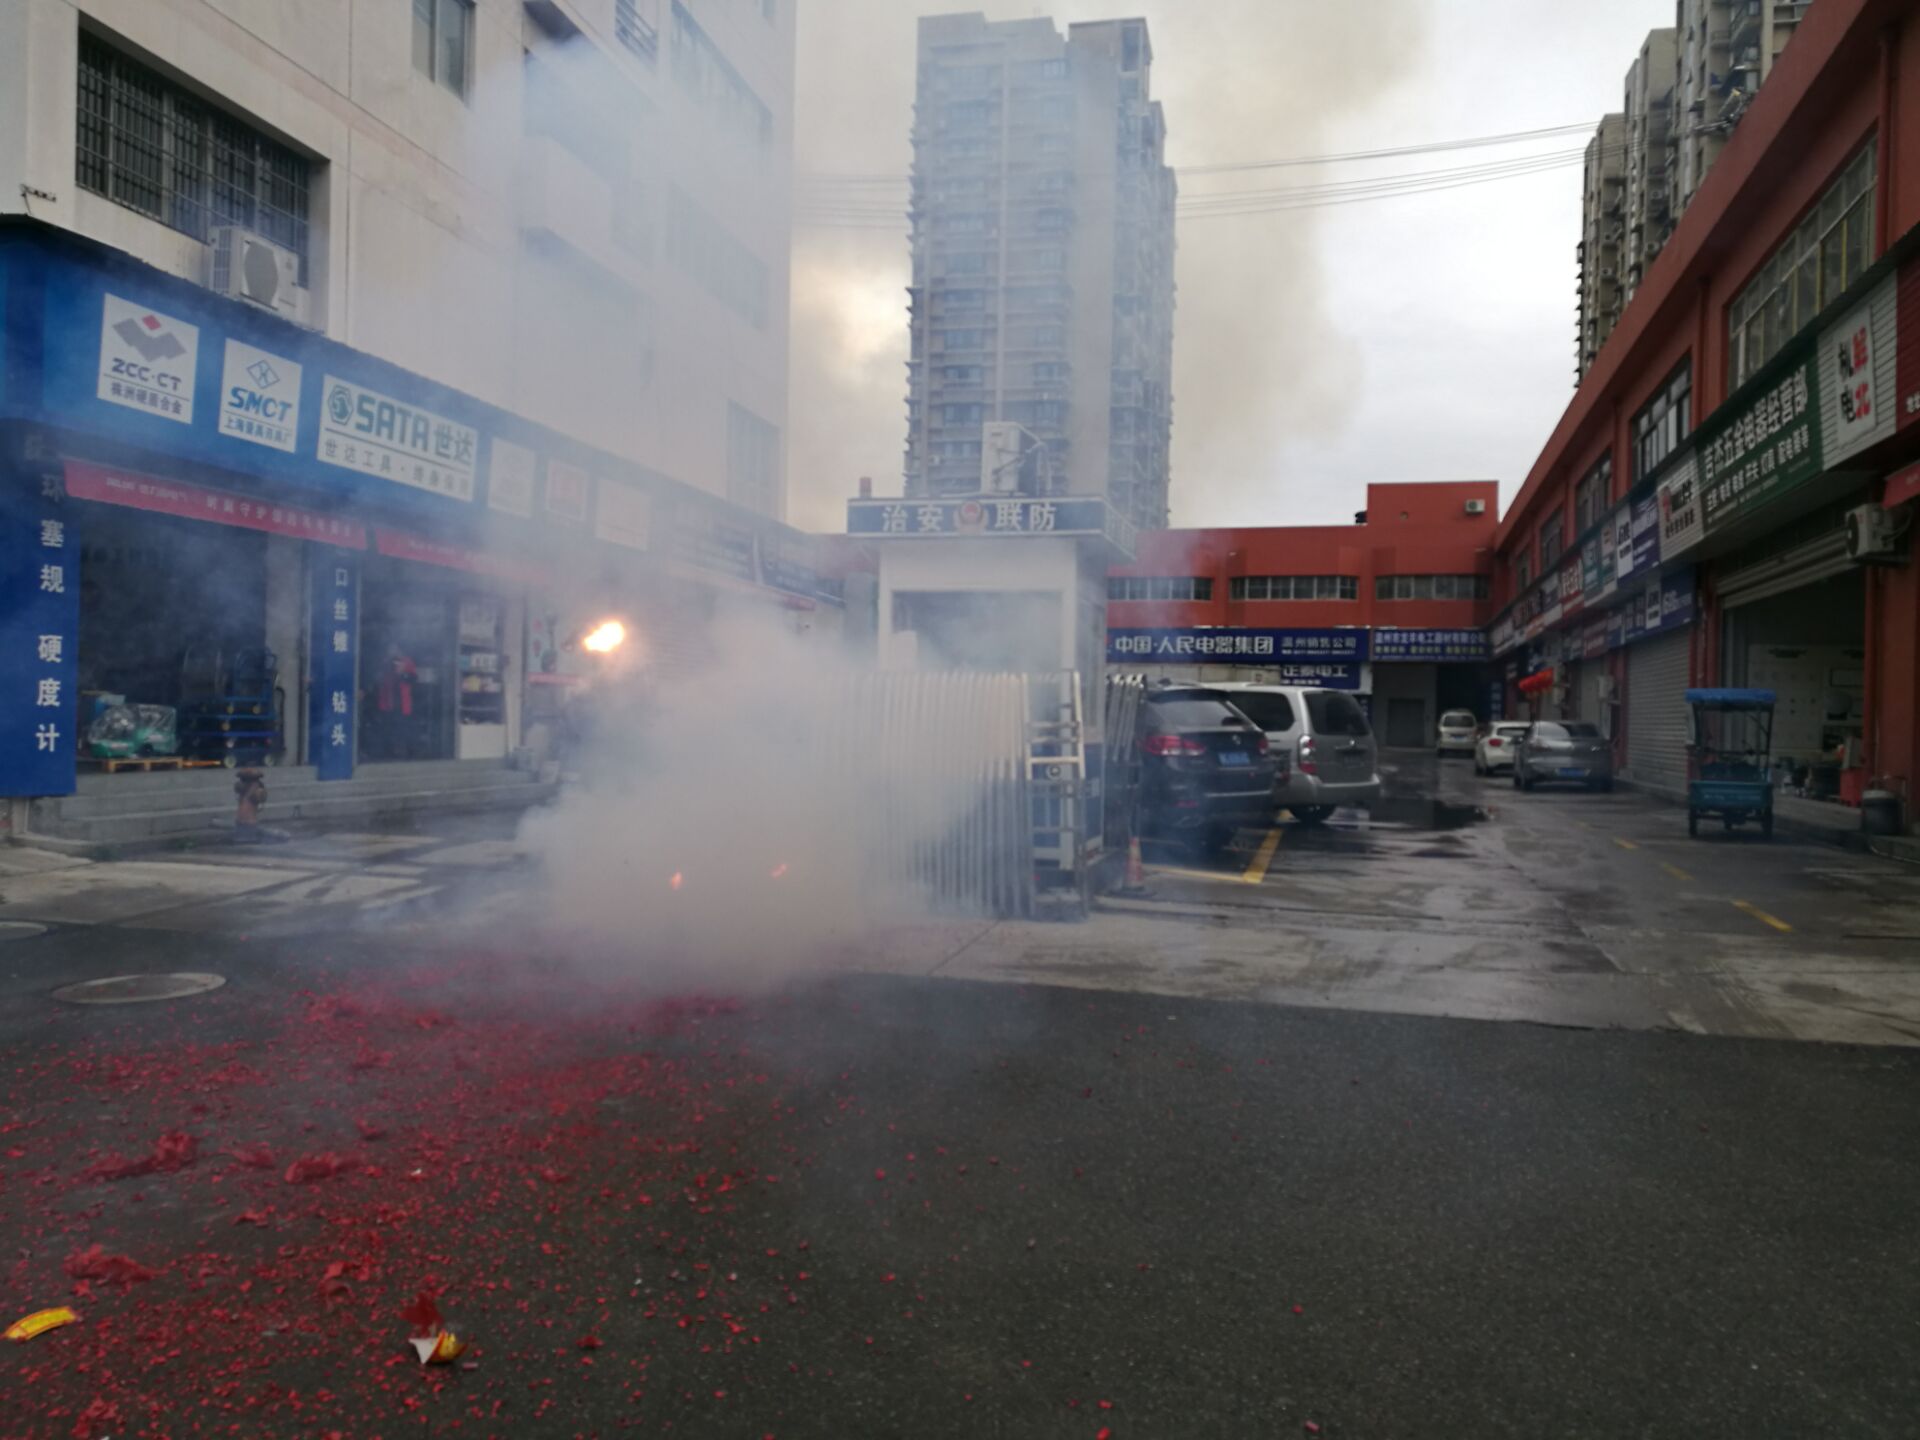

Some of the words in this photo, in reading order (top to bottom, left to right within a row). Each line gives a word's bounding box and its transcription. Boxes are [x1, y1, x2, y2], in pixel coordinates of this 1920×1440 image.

[228, 386, 292, 422] SMCT
[35, 635, 63, 752] 硬度计
[331, 689, 348, 746] 钻头
